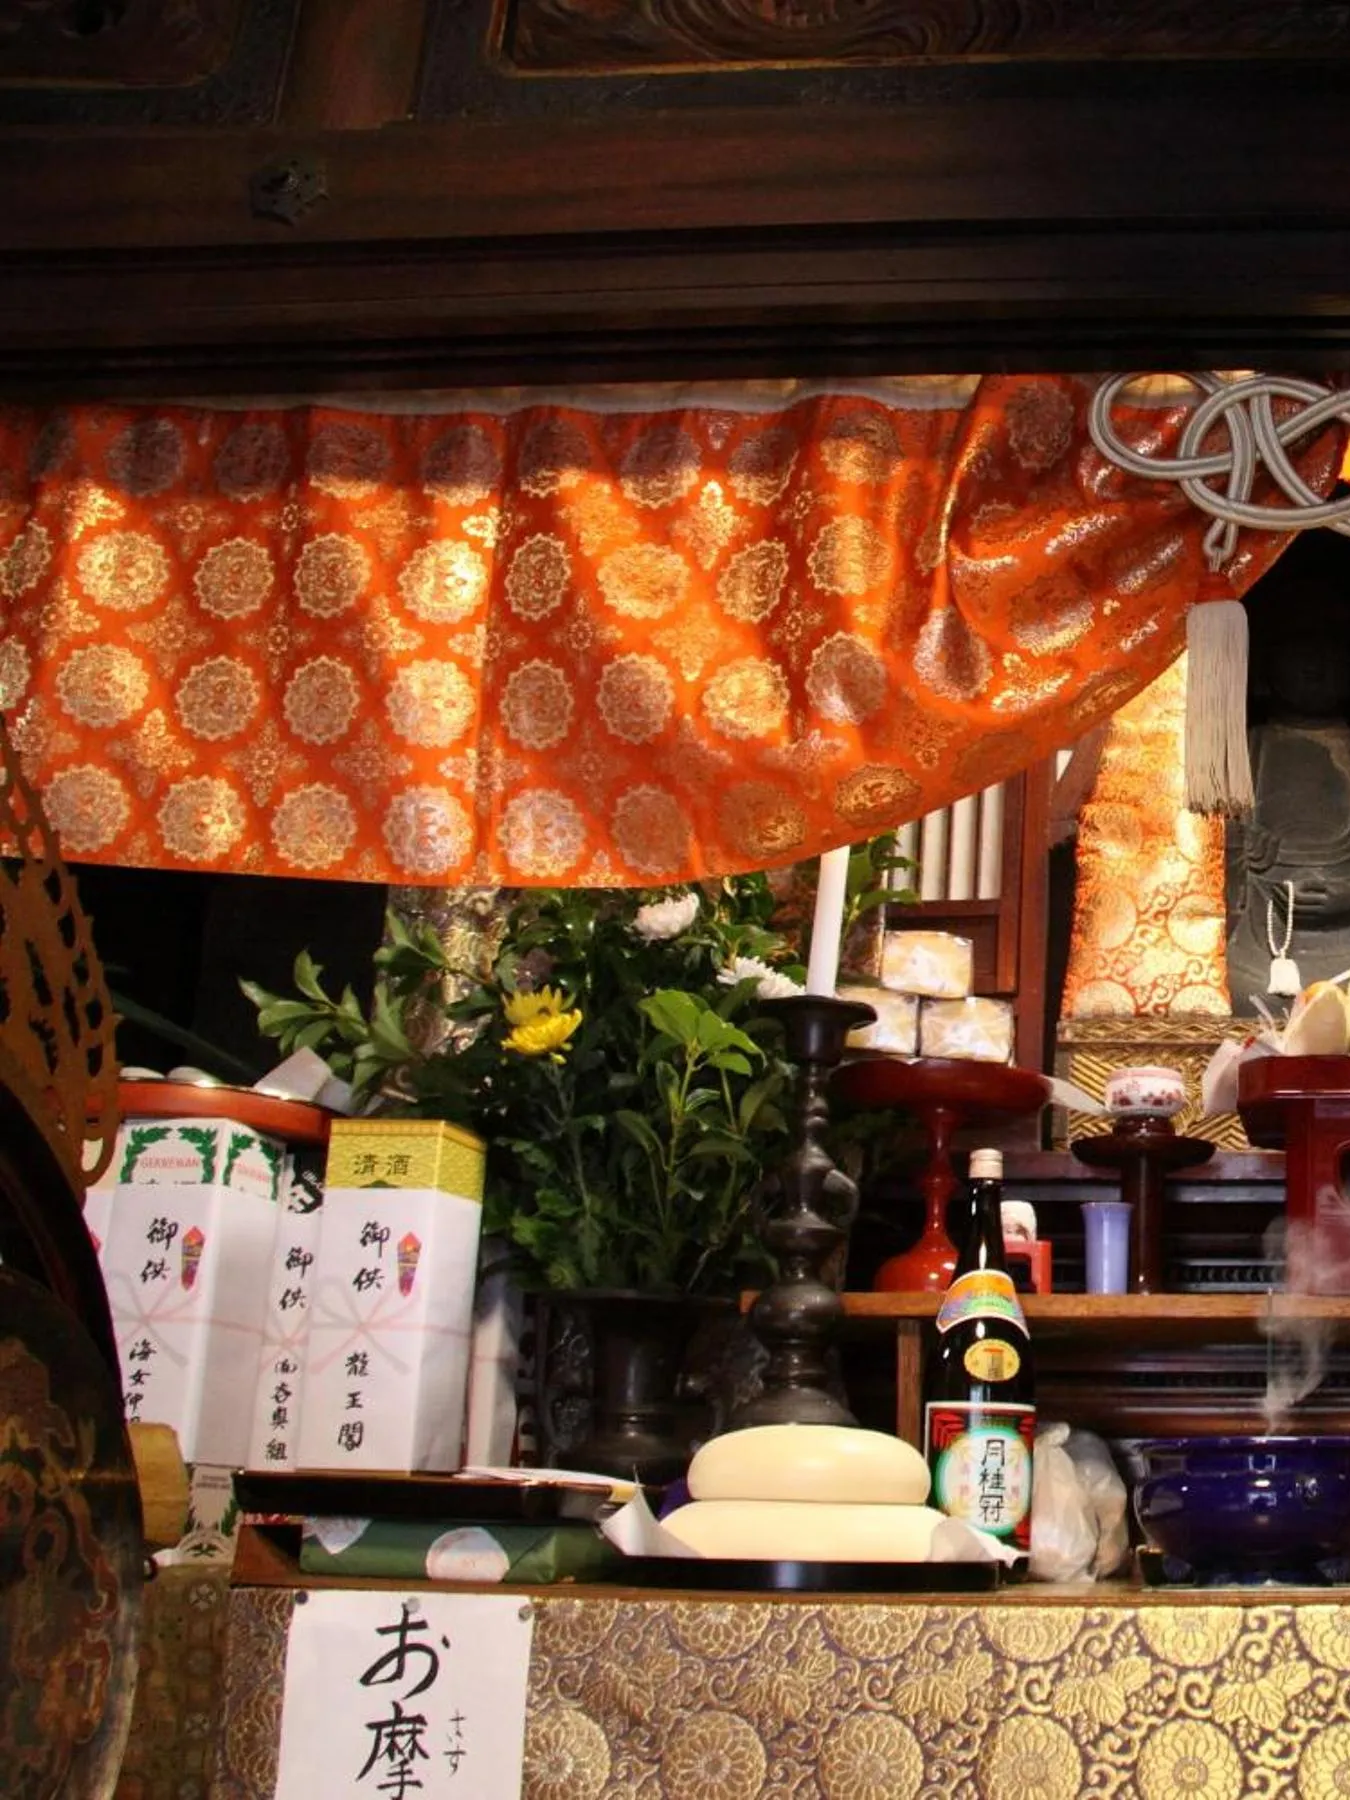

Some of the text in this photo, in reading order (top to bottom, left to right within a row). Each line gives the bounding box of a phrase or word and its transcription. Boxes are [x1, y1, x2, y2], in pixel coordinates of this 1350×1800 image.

[353, 1153, 412, 1176] 清酒
[141, 1217, 179, 1284] 御供
[280, 1246, 314, 1310] 御供
[352, 1220, 390, 1293] 御供
[979, 1439, 1006, 1522] 月桂冠
